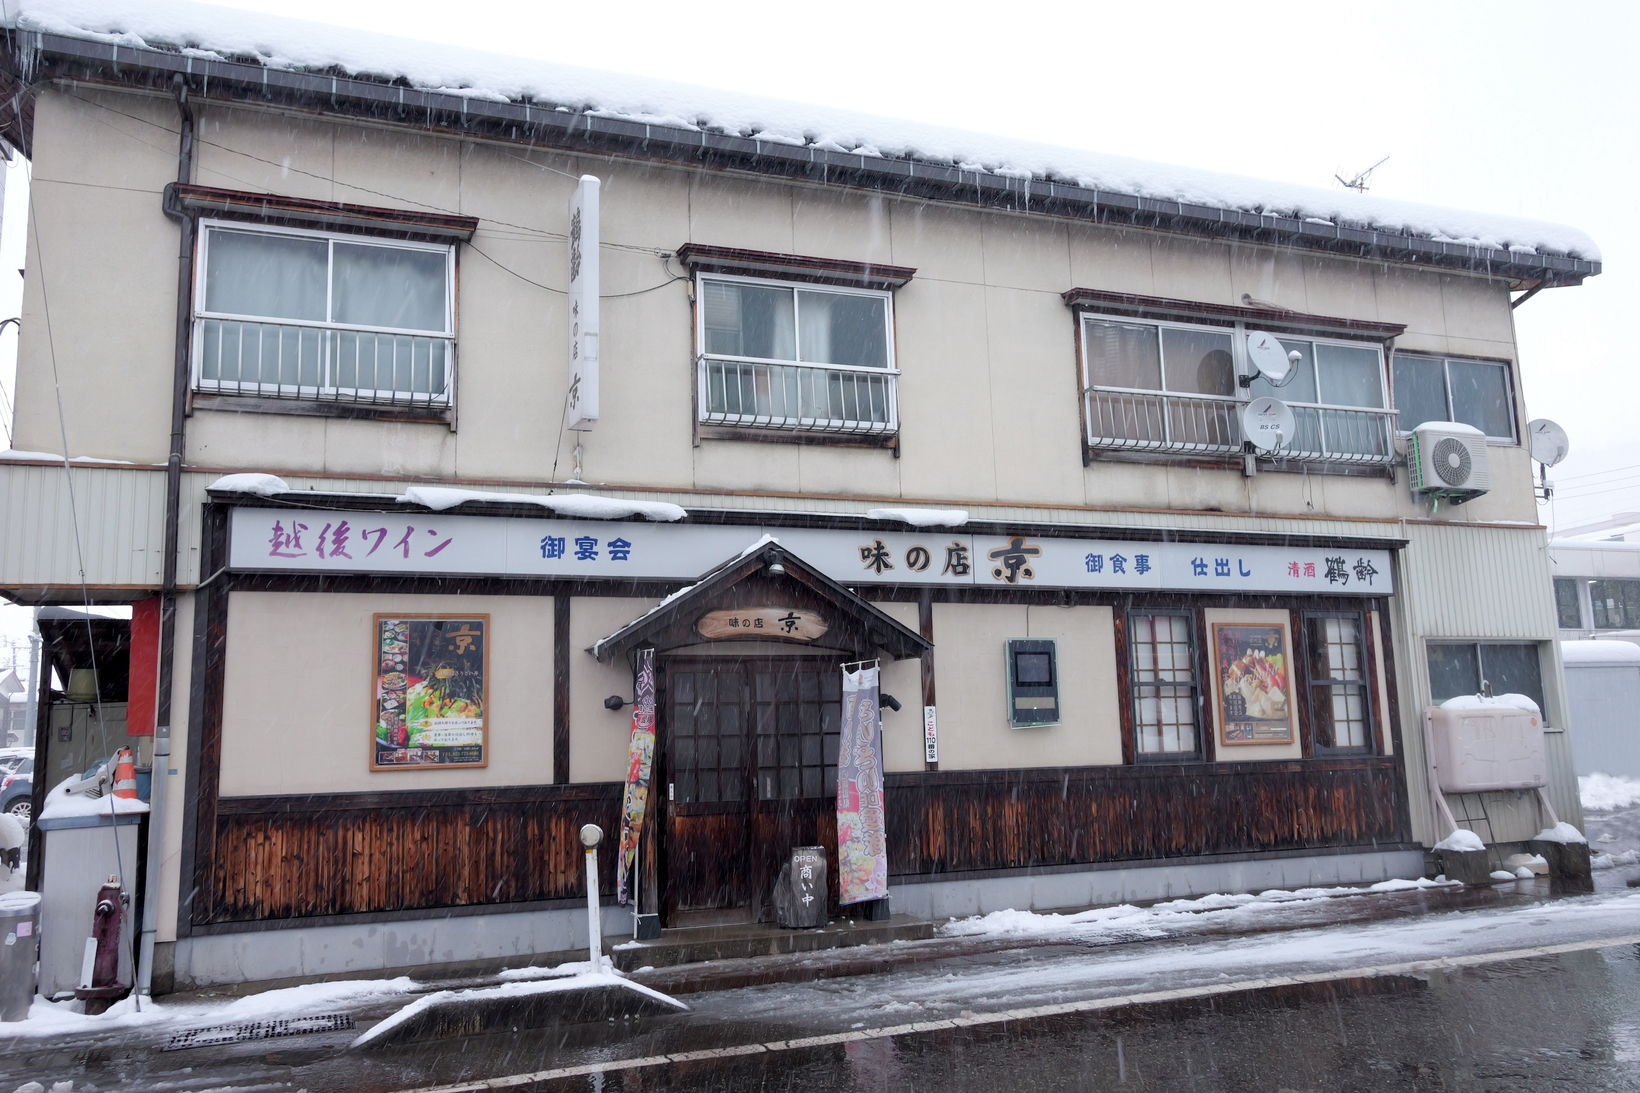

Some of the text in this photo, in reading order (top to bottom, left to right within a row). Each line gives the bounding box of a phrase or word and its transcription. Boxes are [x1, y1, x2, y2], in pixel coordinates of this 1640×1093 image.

[569, 372, 581, 411] 京
[268, 518, 454, 560] 越後ワイン
[540, 535, 632, 562] 御宴会
[858, 537, 1041, 585] 味の店 京
[1085, 552, 1152, 576] 御食事
[1190, 556, 1251, 577] 仕出し
[1287, 560, 1316, 578] 清酒
[728, 611, 802, 634] 味の店 京
[445, 623, 481, 655] 京
[793, 855, 818, 863] OPEN
[800, 864, 815, 907] 商い中
